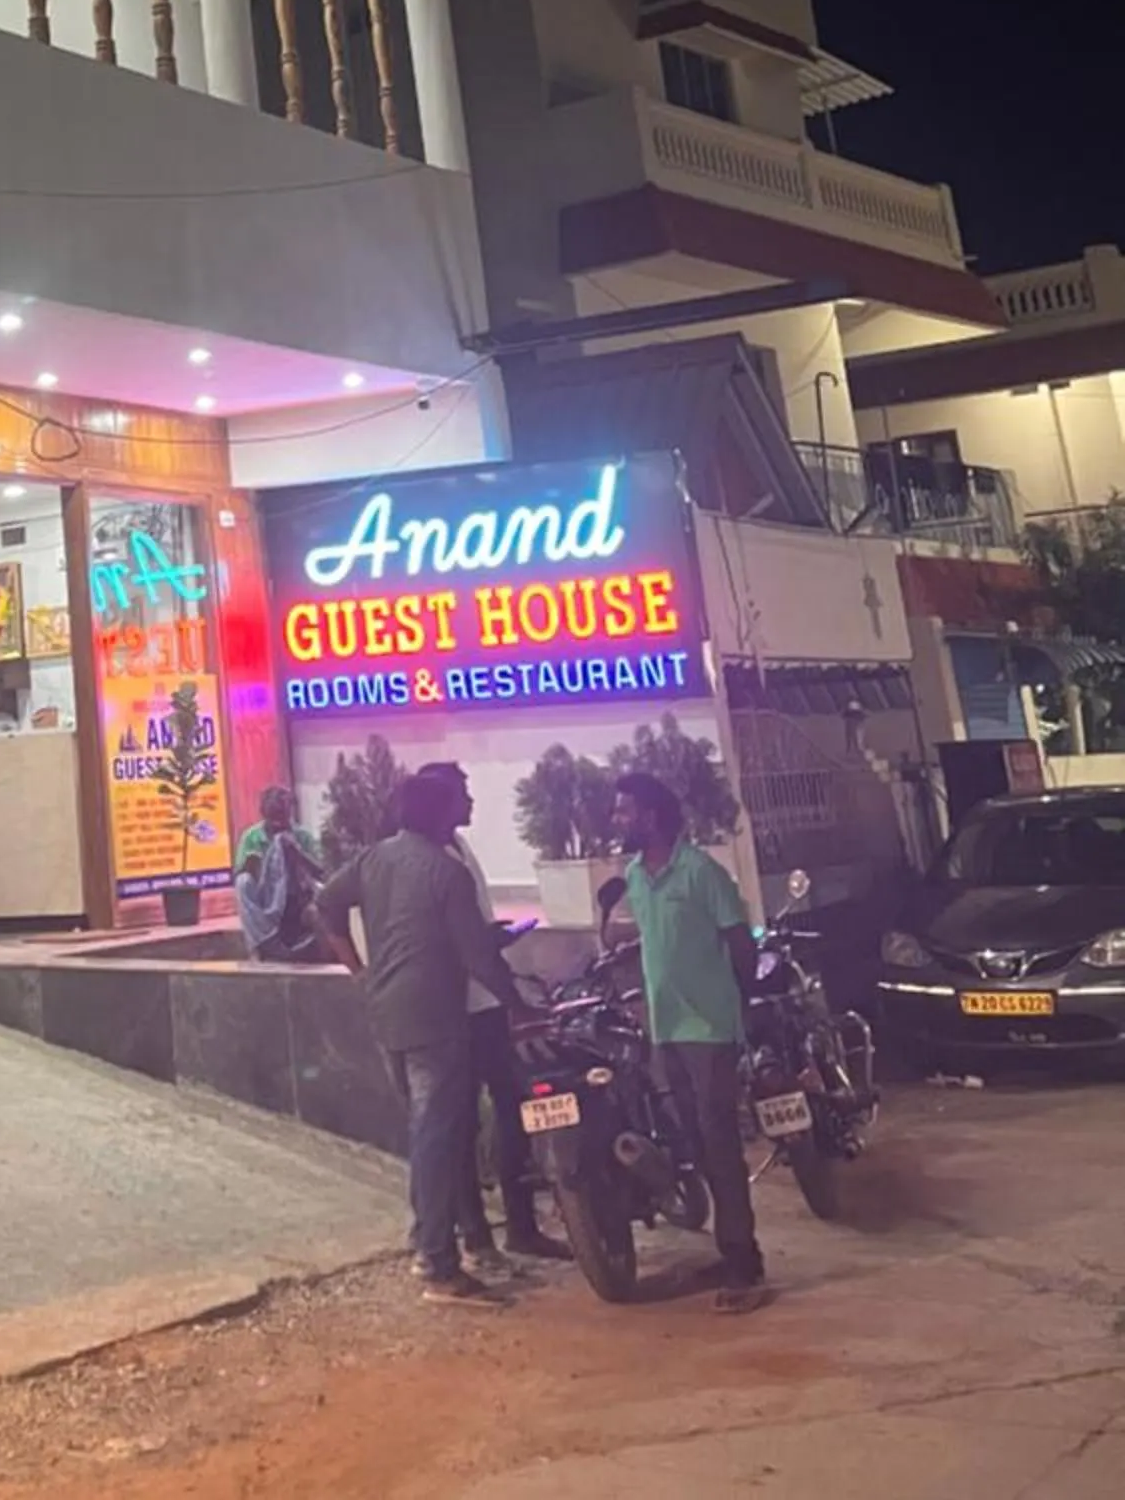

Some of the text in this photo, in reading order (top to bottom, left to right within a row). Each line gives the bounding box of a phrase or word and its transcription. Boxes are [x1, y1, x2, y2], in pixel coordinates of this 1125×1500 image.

[304, 464, 625, 586] Anand
[284, 571, 679, 661] GUEST HOUSE
[147, 717, 215, 750] AND
